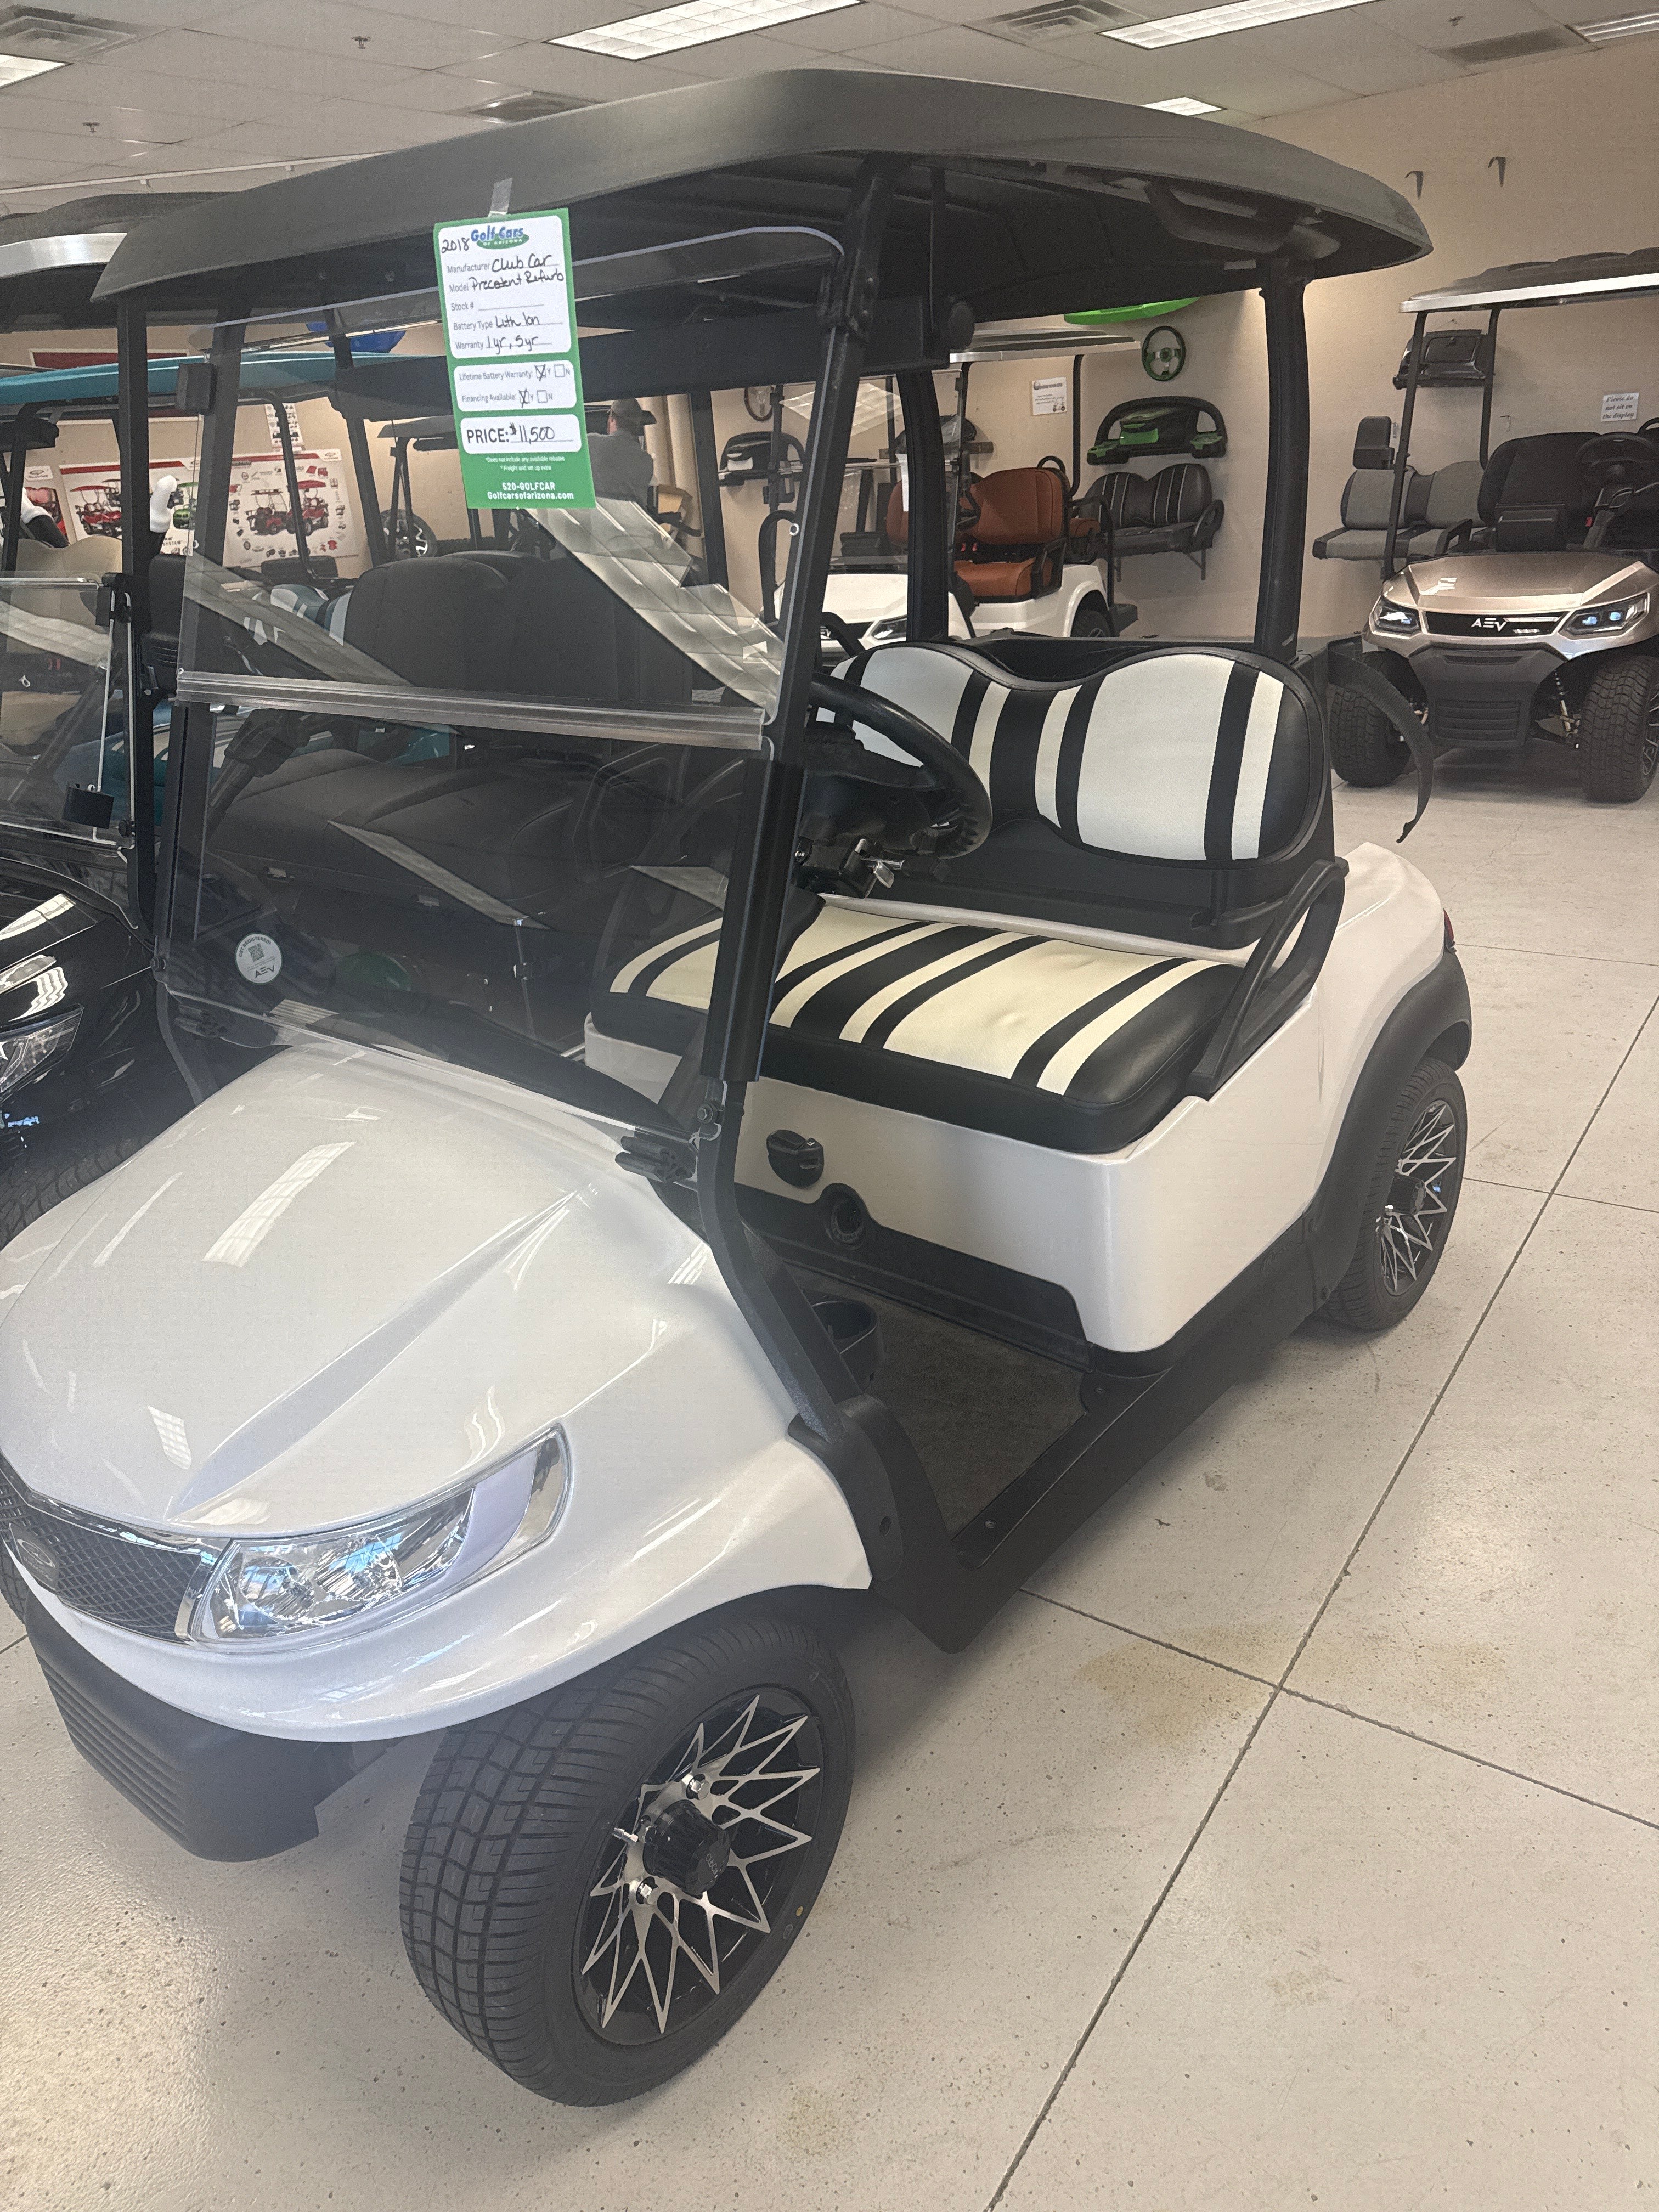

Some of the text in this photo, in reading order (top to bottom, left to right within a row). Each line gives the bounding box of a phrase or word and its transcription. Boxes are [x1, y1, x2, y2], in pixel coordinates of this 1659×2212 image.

[471, 225, 523, 241] Golf Cars
[441, 237, 470, 253] 2018
[447, 253, 552, 273] Manufacturer Club Car
[449, 283, 469, 292] Model
[524, 268, 565, 284] Refurb
[451, 302, 469, 311] Stock
[453, 321, 476, 331] Battery
[477, 320, 493, 330] Type
[455, 341, 484, 350] Warranty
[483, 371, 504, 380] Battery
[505, 370, 533, 379] Warranty:
[489, 393, 516, 401] Available:
[466, 428, 509, 443] PRICE:
[502, 482, 555, 490] 520-GOLFCAR
[487, 491, 574, 500] Golfcarsofarizona.com
[1471, 618, 1507, 632] AEV
[255, 965, 274, 978] AEV
